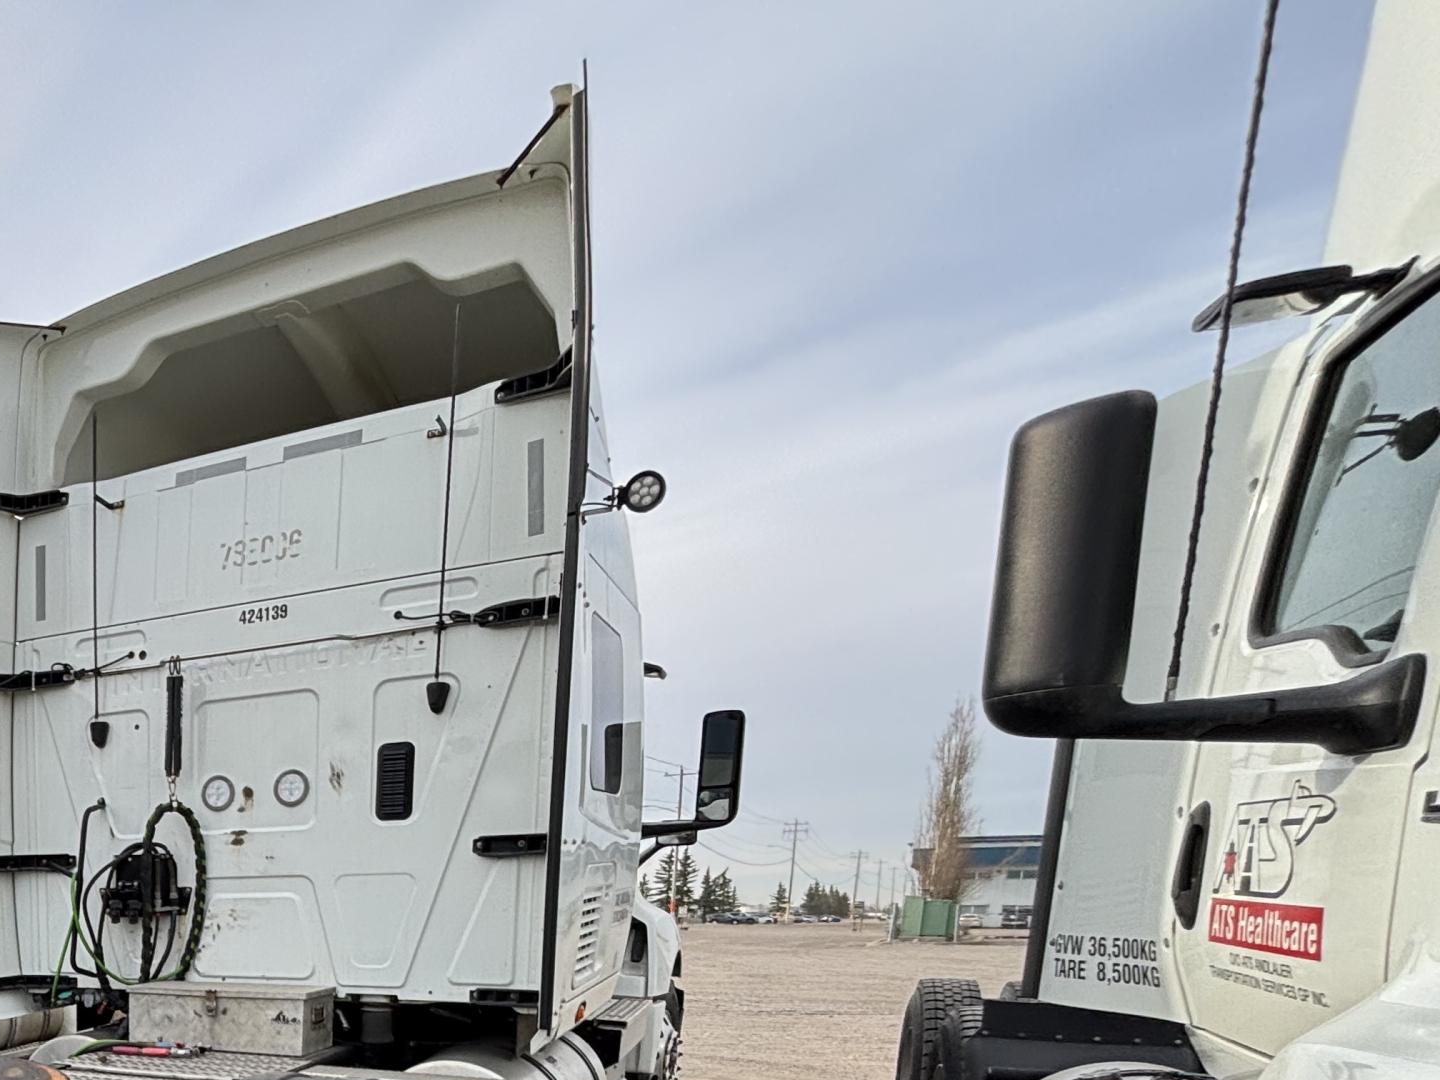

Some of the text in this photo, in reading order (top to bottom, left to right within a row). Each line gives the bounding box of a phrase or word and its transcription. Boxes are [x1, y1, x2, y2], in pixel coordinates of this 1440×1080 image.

[238, 603, 289, 625] 424139
[1211, 904, 1319, 955] ATS Healthcare
[1055, 933, 1157, 962] GVW 36,500KG
[1054, 957, 1161, 988] TARE 8,500KG
